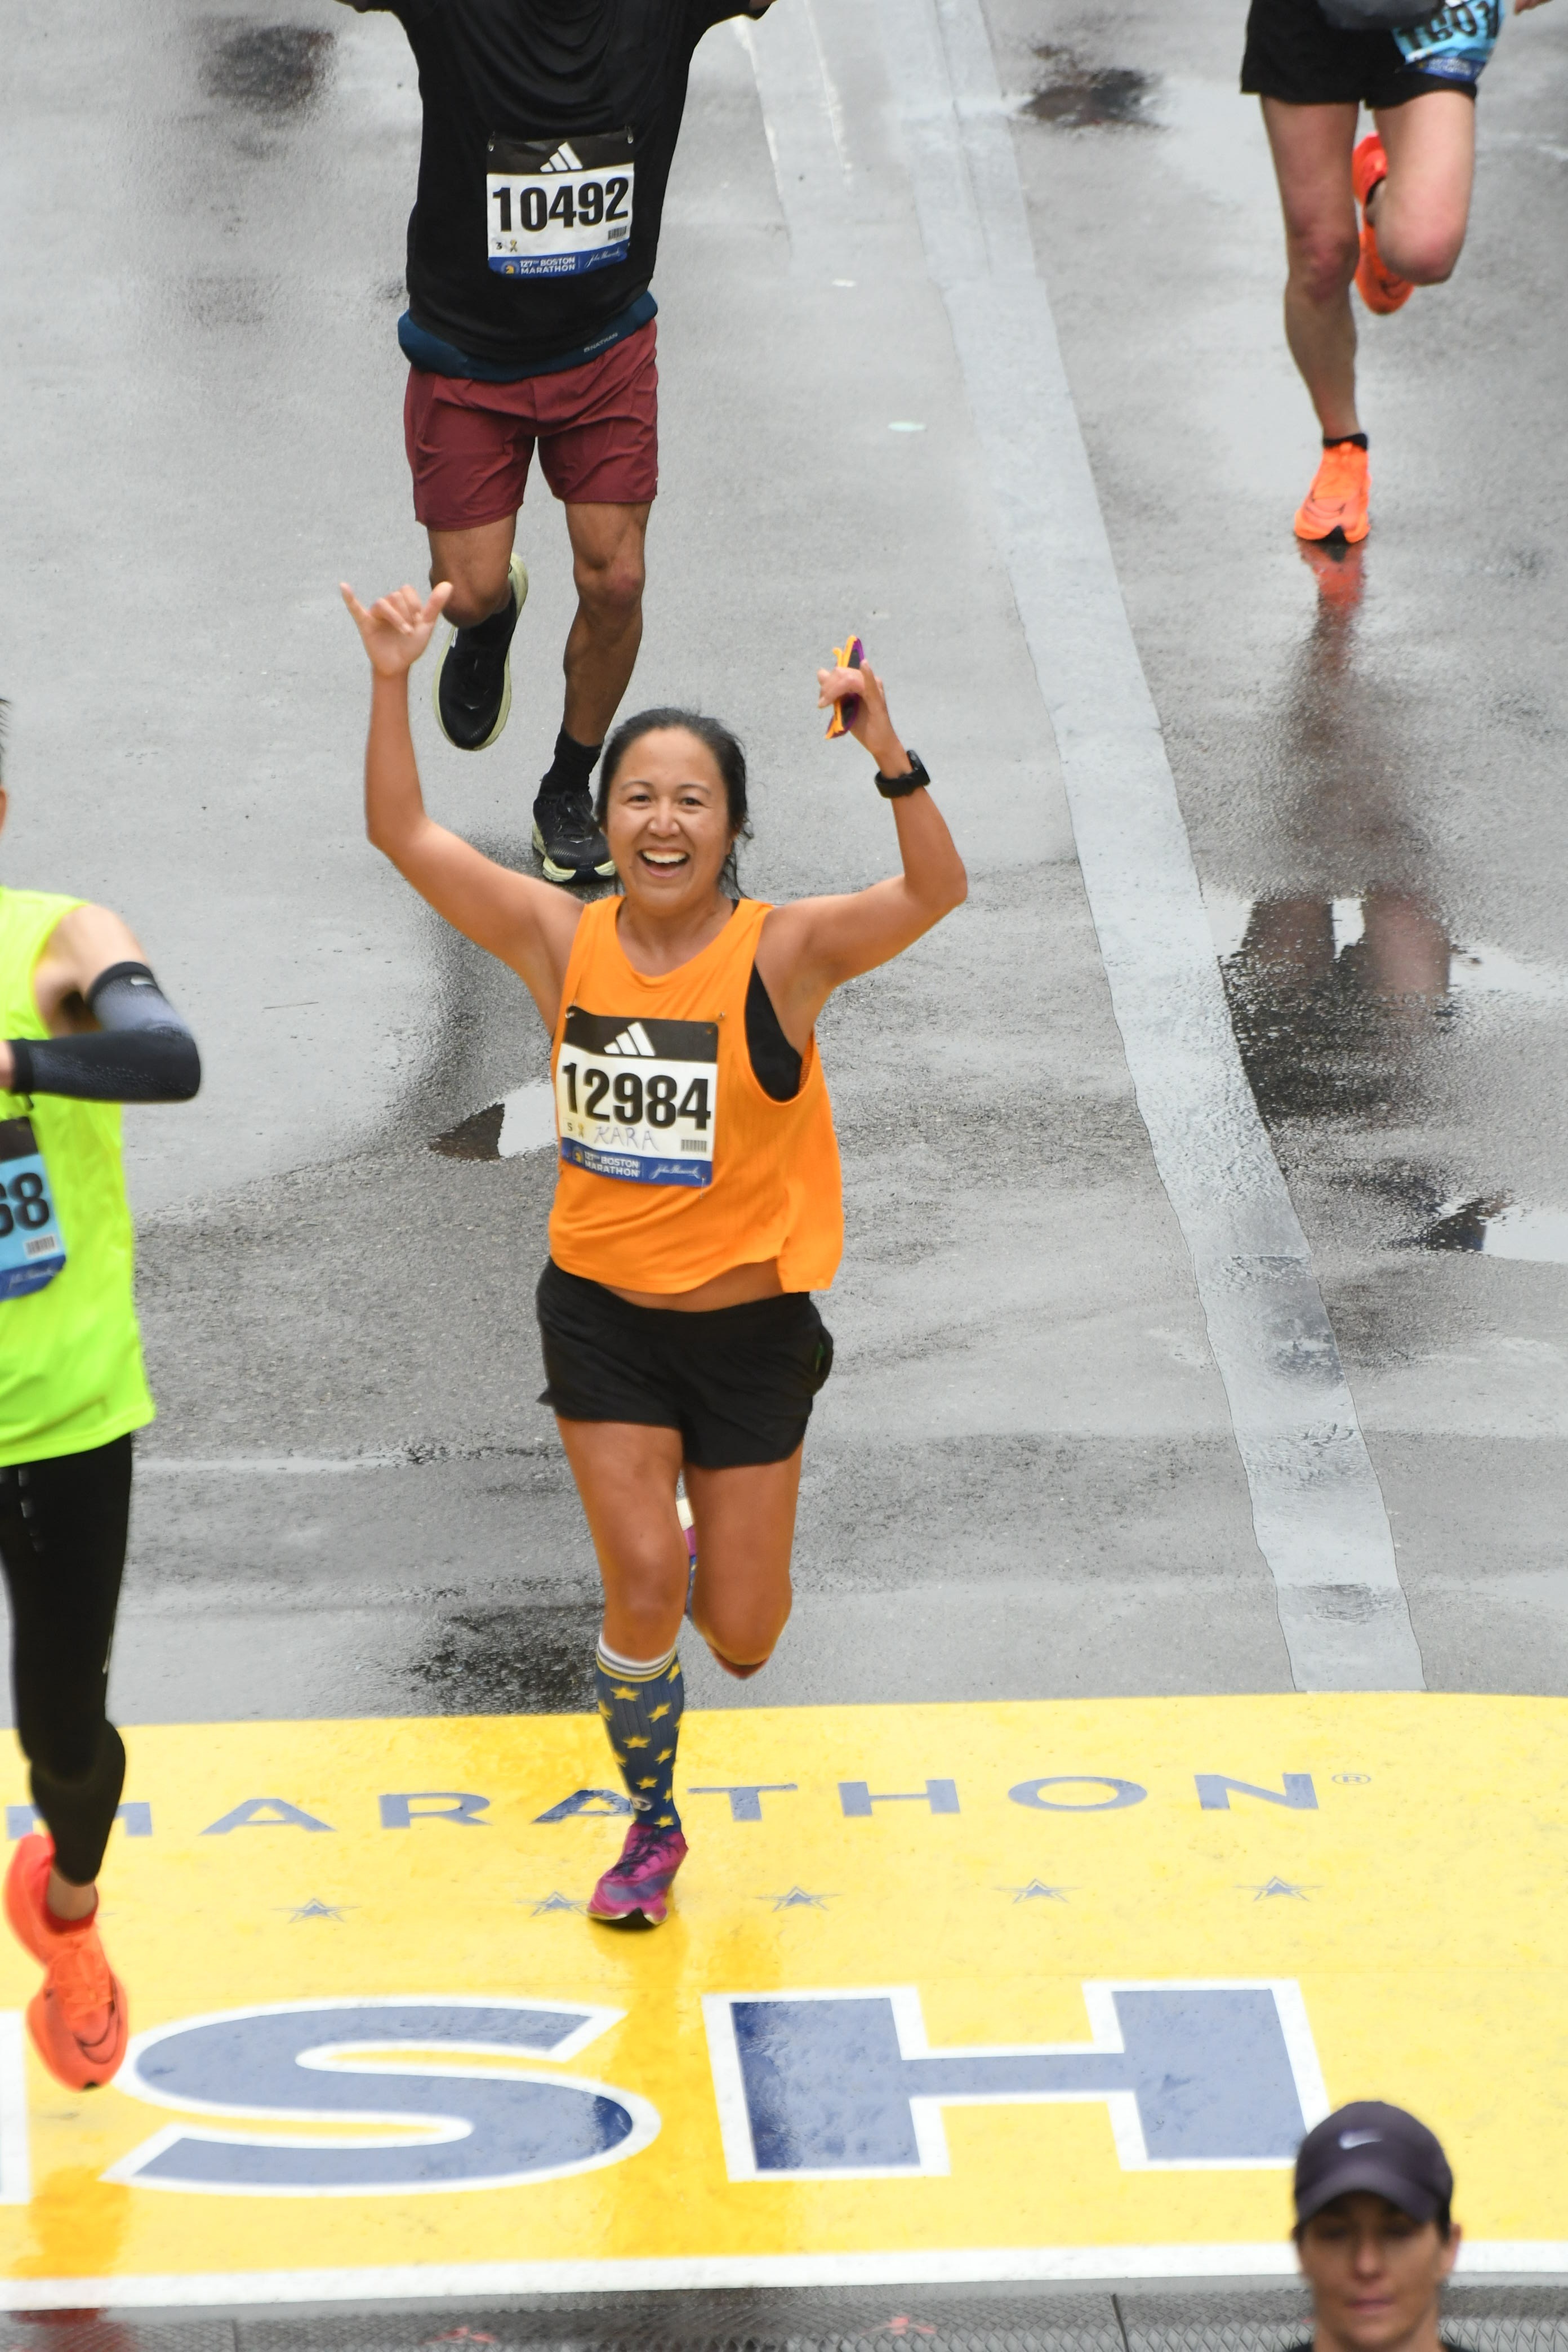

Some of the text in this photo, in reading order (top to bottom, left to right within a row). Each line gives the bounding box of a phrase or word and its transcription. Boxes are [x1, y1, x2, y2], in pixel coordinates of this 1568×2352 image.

[492, 177, 629, 233] 10492
[520, 264, 576, 275] MARATHON
[540, 256, 575, 266] BOSTON
[590, 332, 618, 349] NATHAN
[562, 1062, 711, 1131] 12984
[594, 1126, 659, 1151] KARA
[585, 1160, 639, 1177] MARATHON
[600, 1156, 639, 1169] BOSTON
[0, 1980, 1332, 2204] SH
